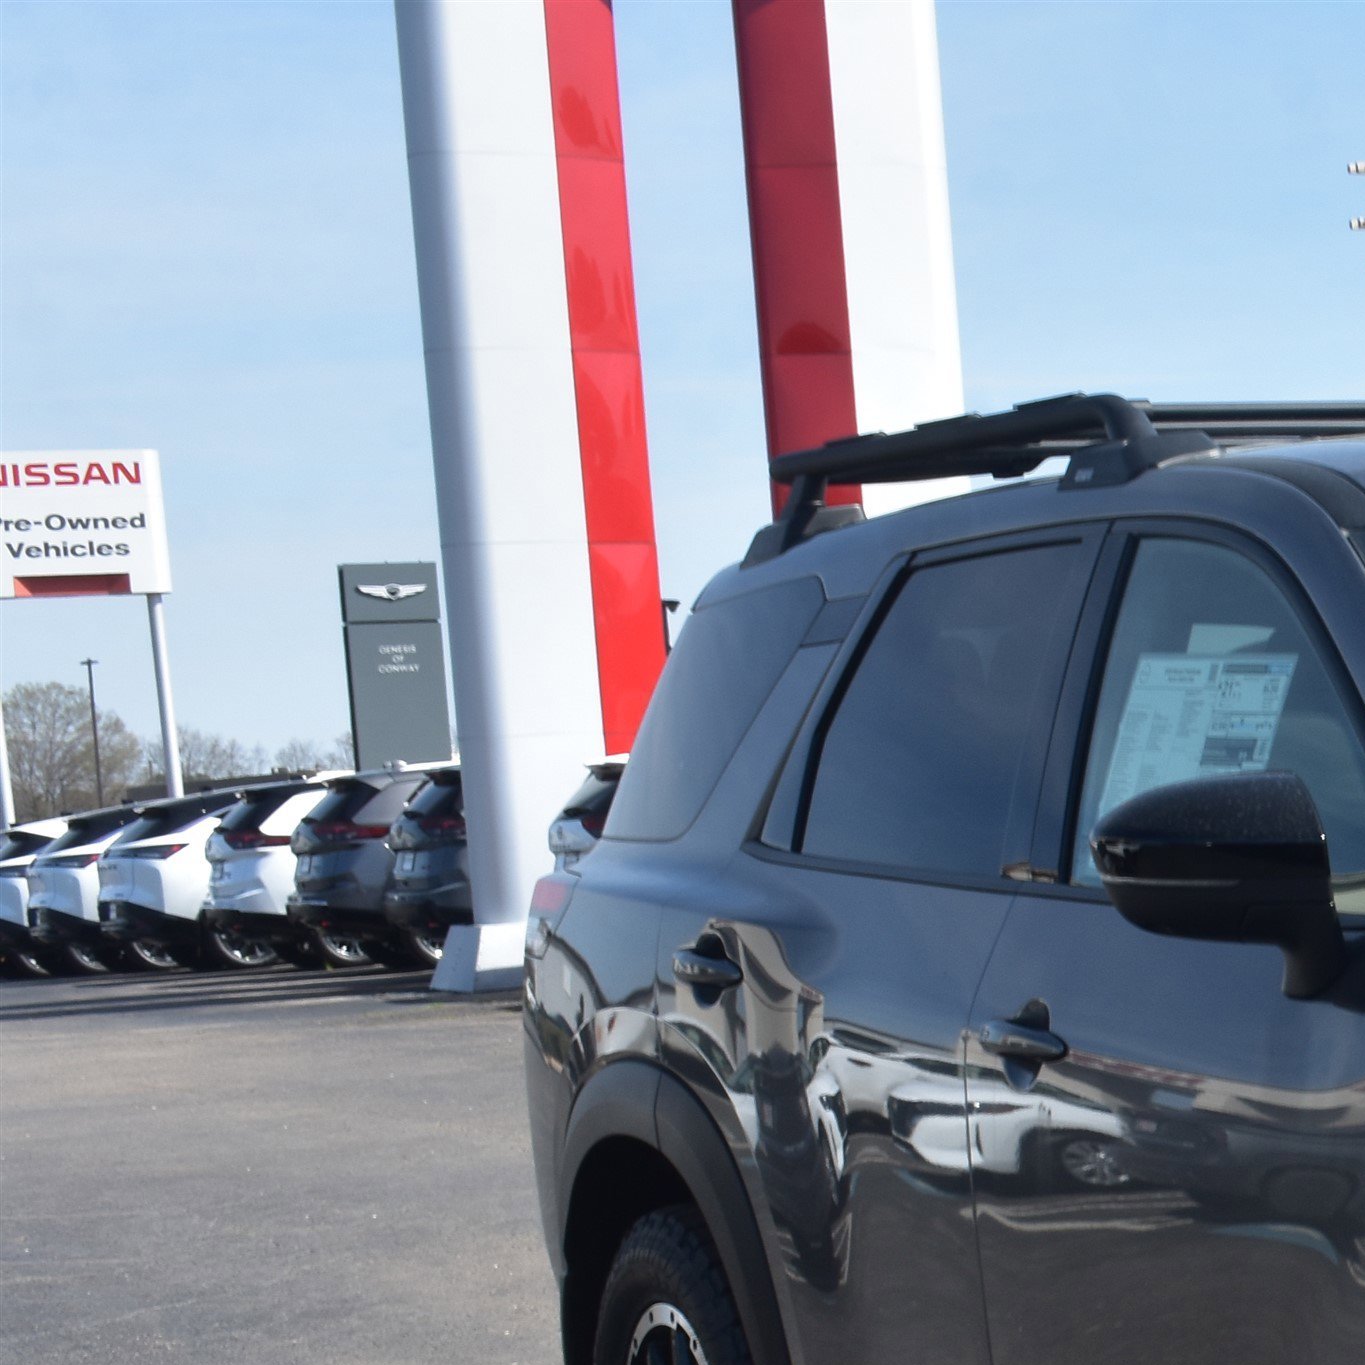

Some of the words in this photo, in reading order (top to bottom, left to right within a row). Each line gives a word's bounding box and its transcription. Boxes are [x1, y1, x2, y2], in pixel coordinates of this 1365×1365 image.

[0, 462, 142, 487] ISSAN
[0, 512, 146, 532] re-Owned
[6, 540, 131, 559] Vehicles
